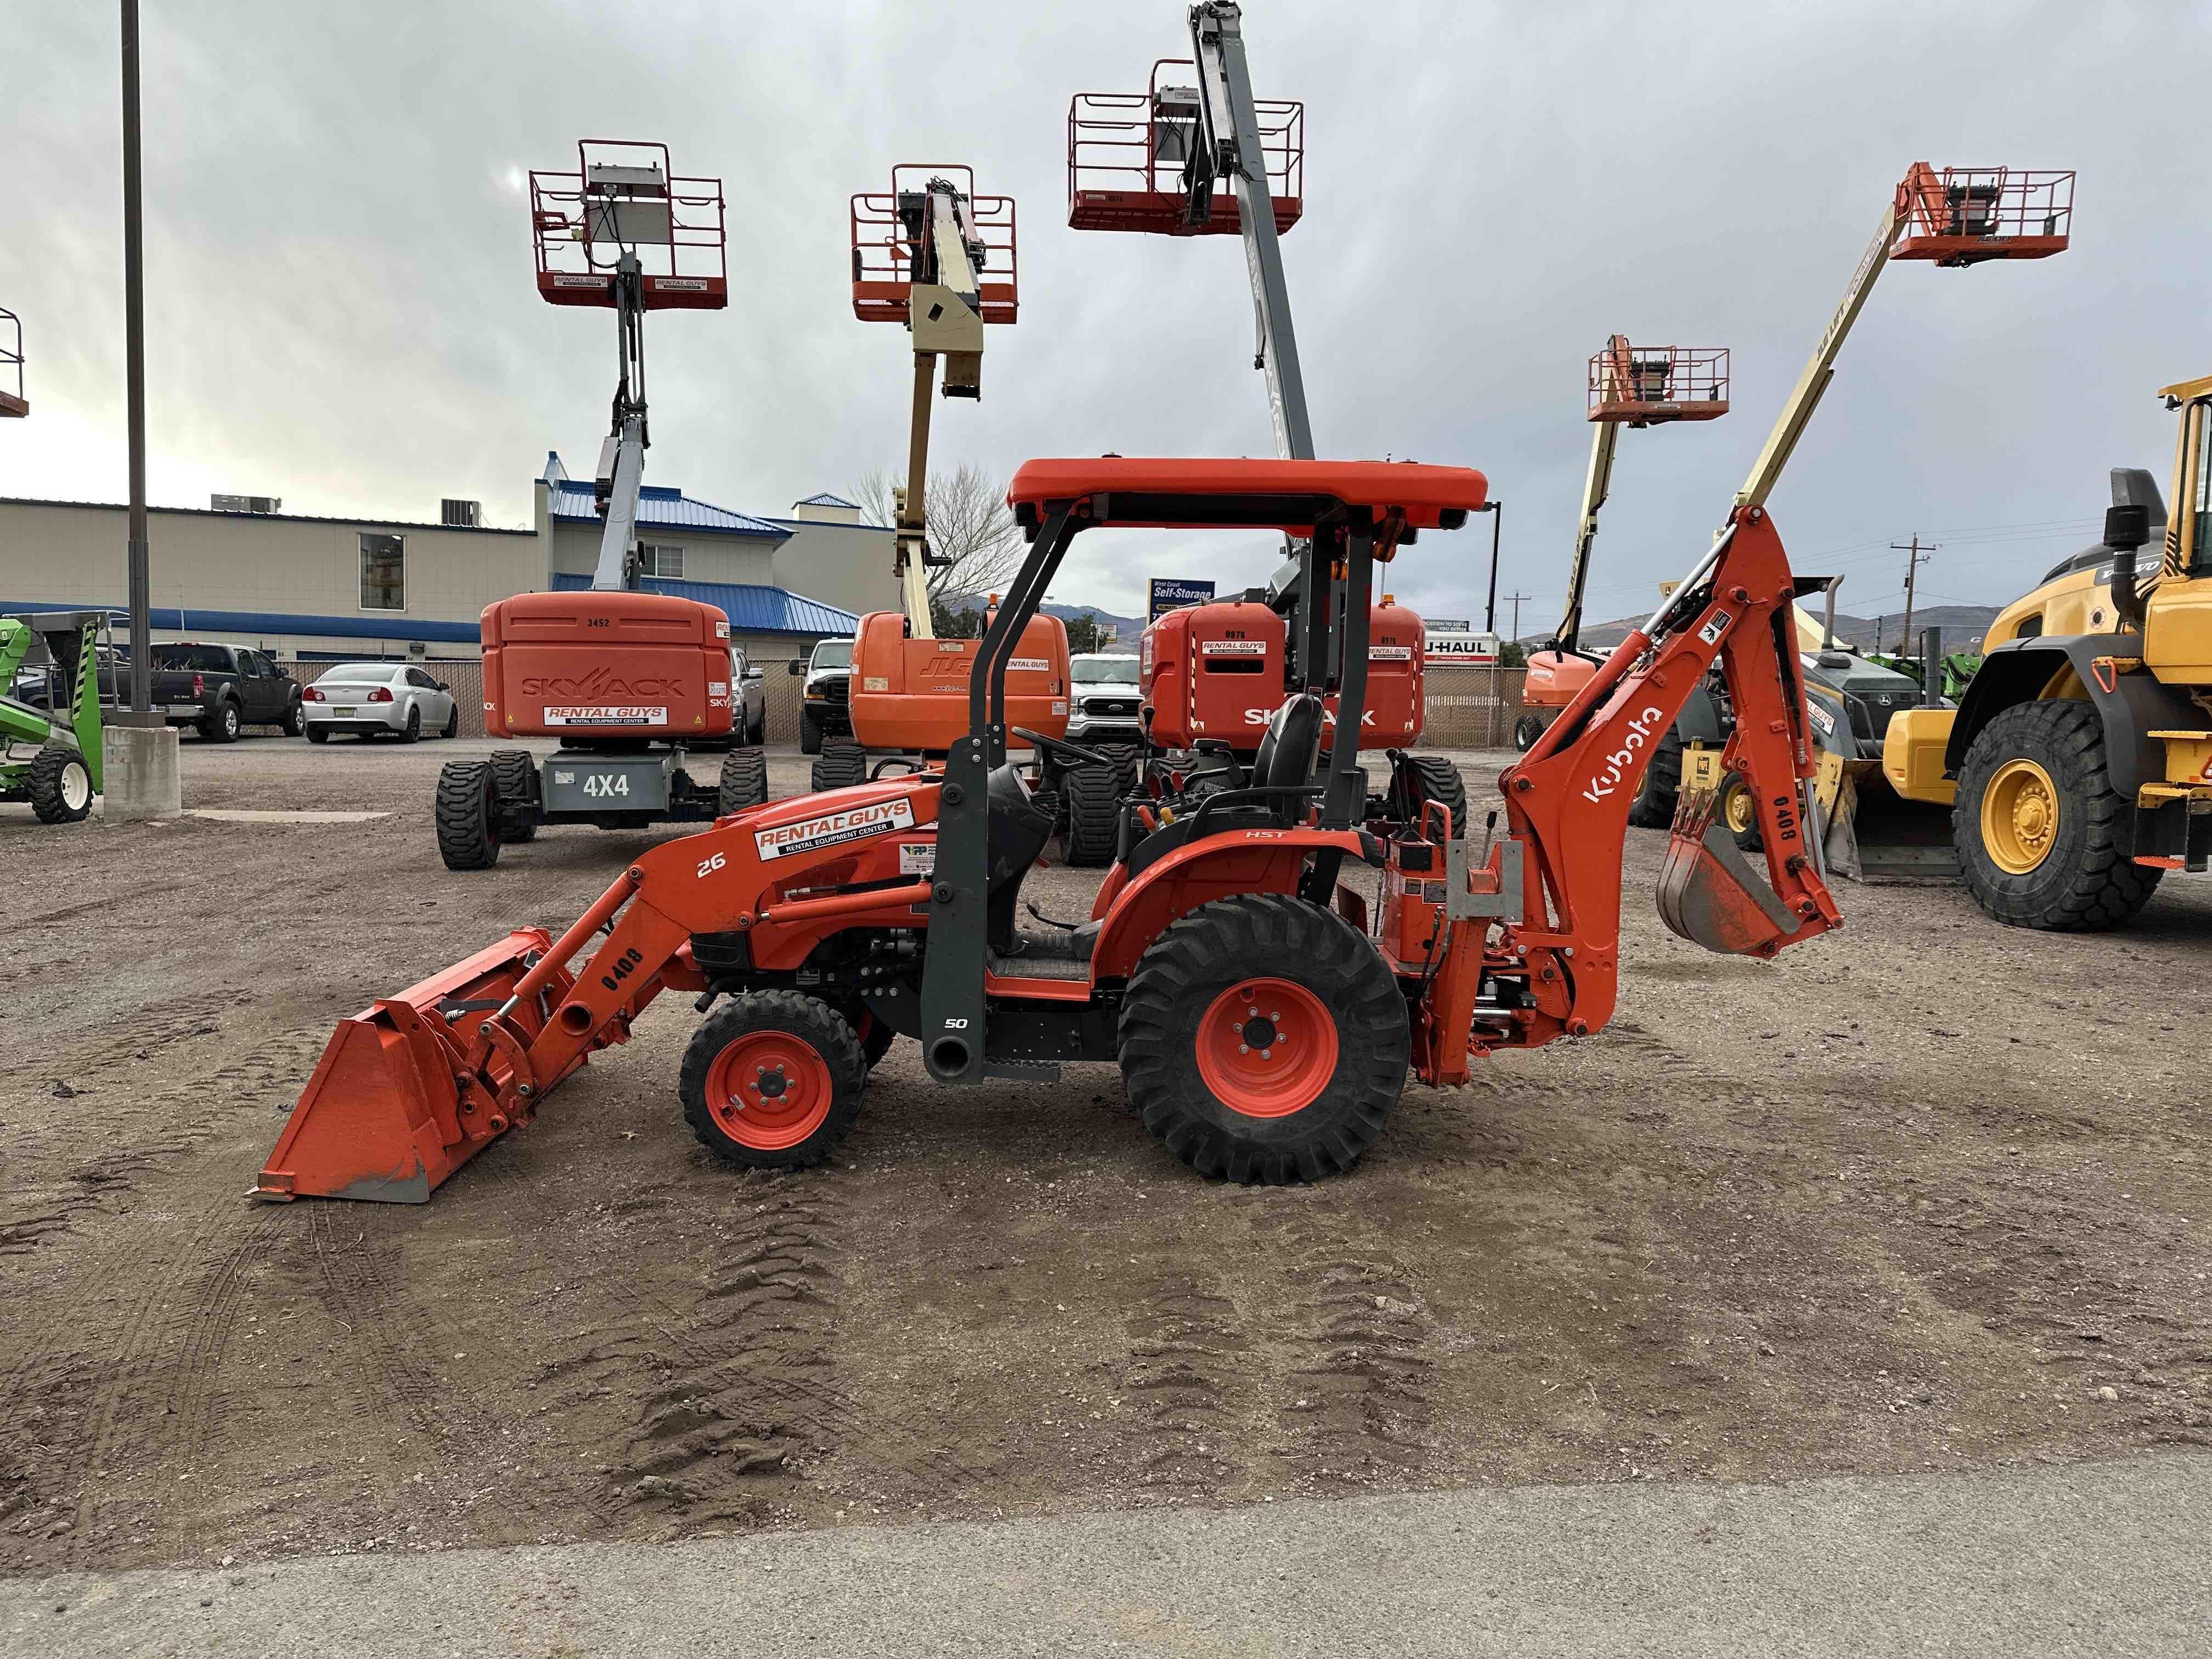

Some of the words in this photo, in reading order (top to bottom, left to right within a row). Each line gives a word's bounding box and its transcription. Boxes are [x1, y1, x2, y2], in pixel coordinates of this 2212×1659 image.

[1817, 332, 1829, 362] JLG
[1830, 302, 1844, 337] LIFT
[2103, 561, 2160, 579] VVO
[1154, 587, 1212, 601] Self-Storage
[588, 619, 610, 628] 3452
[919, 657, 972, 678] JLG
[522, 667, 685, 702] SKYJACK
[549, 708, 612, 717] RENTAL
[616, 708, 662, 717] GUYS
[1244, 709, 1376, 726] SKAK
[1814, 707, 1833, 725] GUYS
[1582, 707, 1663, 804] Kubota
[583, 774, 629, 797] 4X4
[760, 816, 845, 848] RENTAL
[851, 802, 908, 824] GUYS
[1773, 797, 1797, 840] 0408
[786, 840, 814, 851] RENTAL
[815, 830, 857, 845] EQUIPMENT
[859, 823, 887, 836] CENTER
[697, 851, 726, 878] 26
[601, 948, 643, 991] 0408
[944, 1019, 968, 1029] 50
